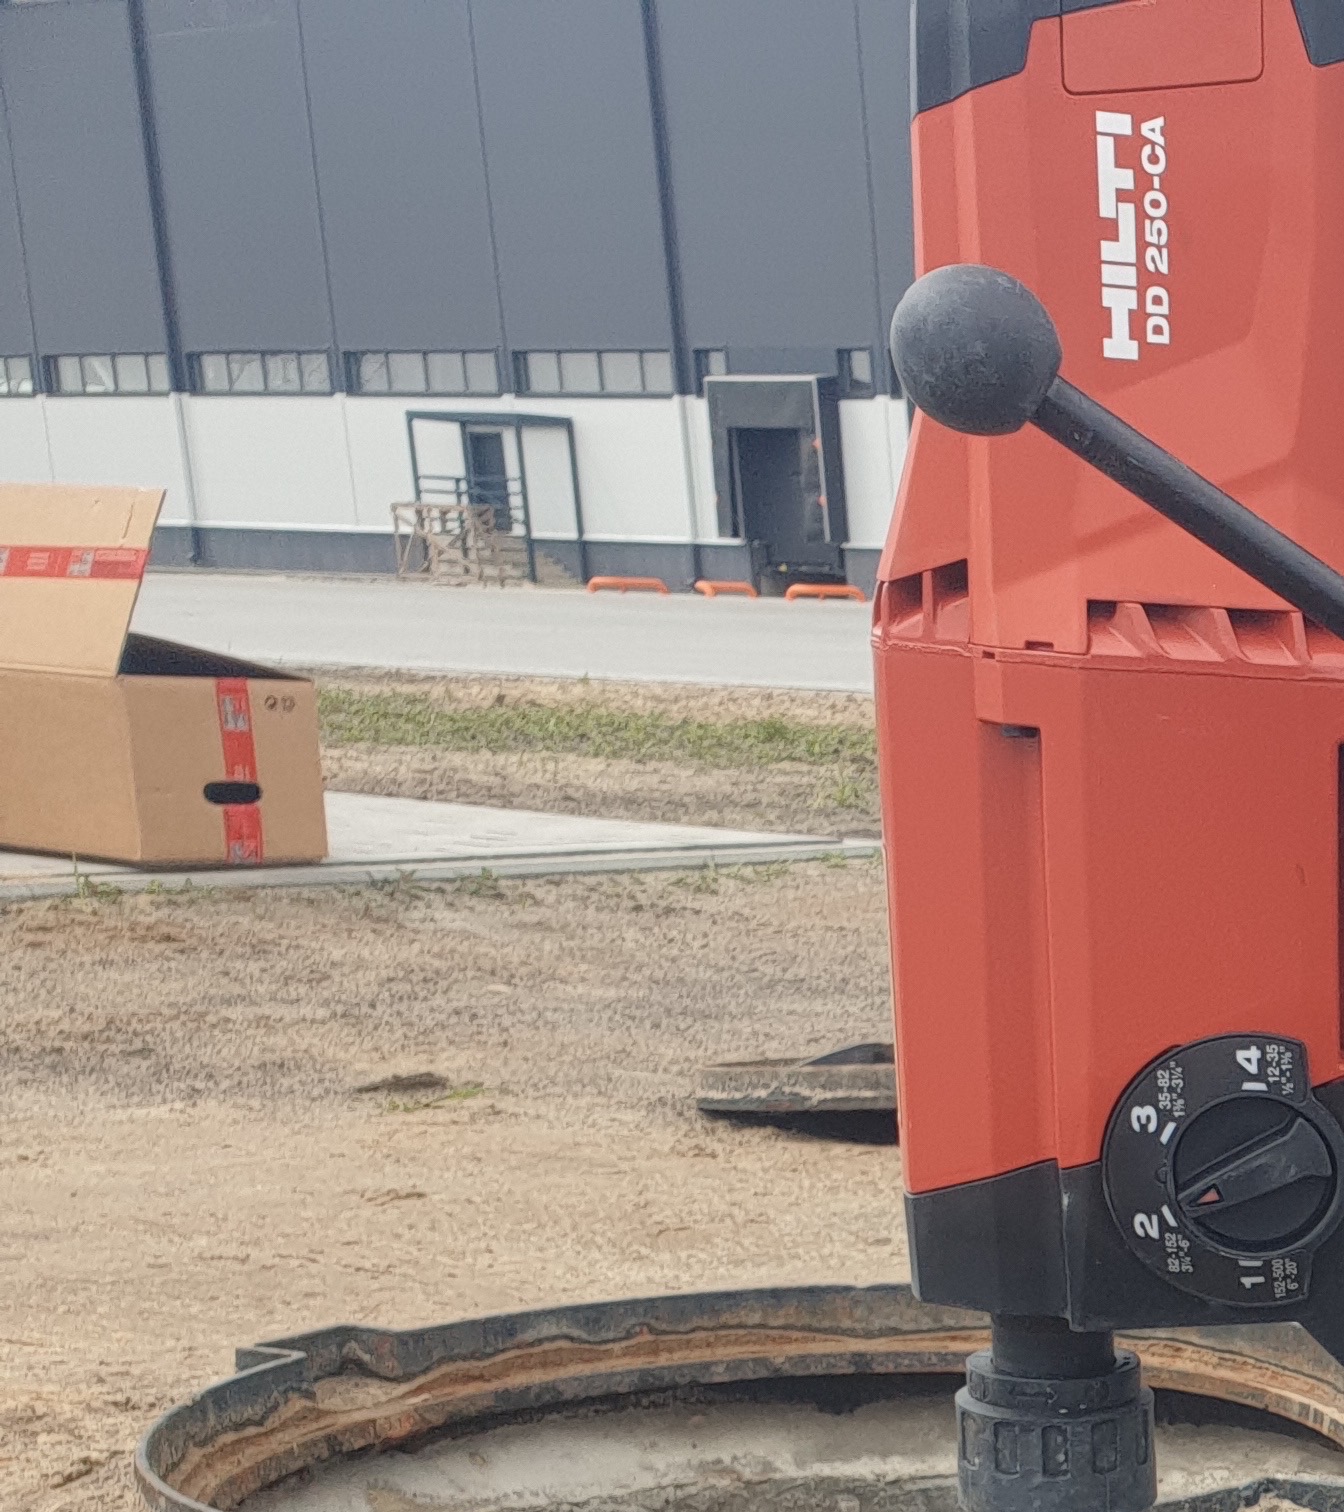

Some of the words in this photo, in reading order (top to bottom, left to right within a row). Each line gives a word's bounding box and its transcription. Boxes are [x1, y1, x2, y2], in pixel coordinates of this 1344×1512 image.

[1140, 116, 1169, 275] 250-CA
[1095, 110, 1139, 361] HILTI
[1145, 286, 1170, 345] DD
[1236, 1045, 1262, 1075] 4
[1265, 1044, 1280, 1083] 12-35
[1156, 1069, 1171, 1110] 35-82
[1130, 1105, 1158, 1134] 3
[1133, 1212, 1160, 1240] 2
[1164, 1232, 1180, 1272] 82-152
[1240, 1276, 1265, 1289] 1
[1271, 1258, 1286, 1299] 152-500
